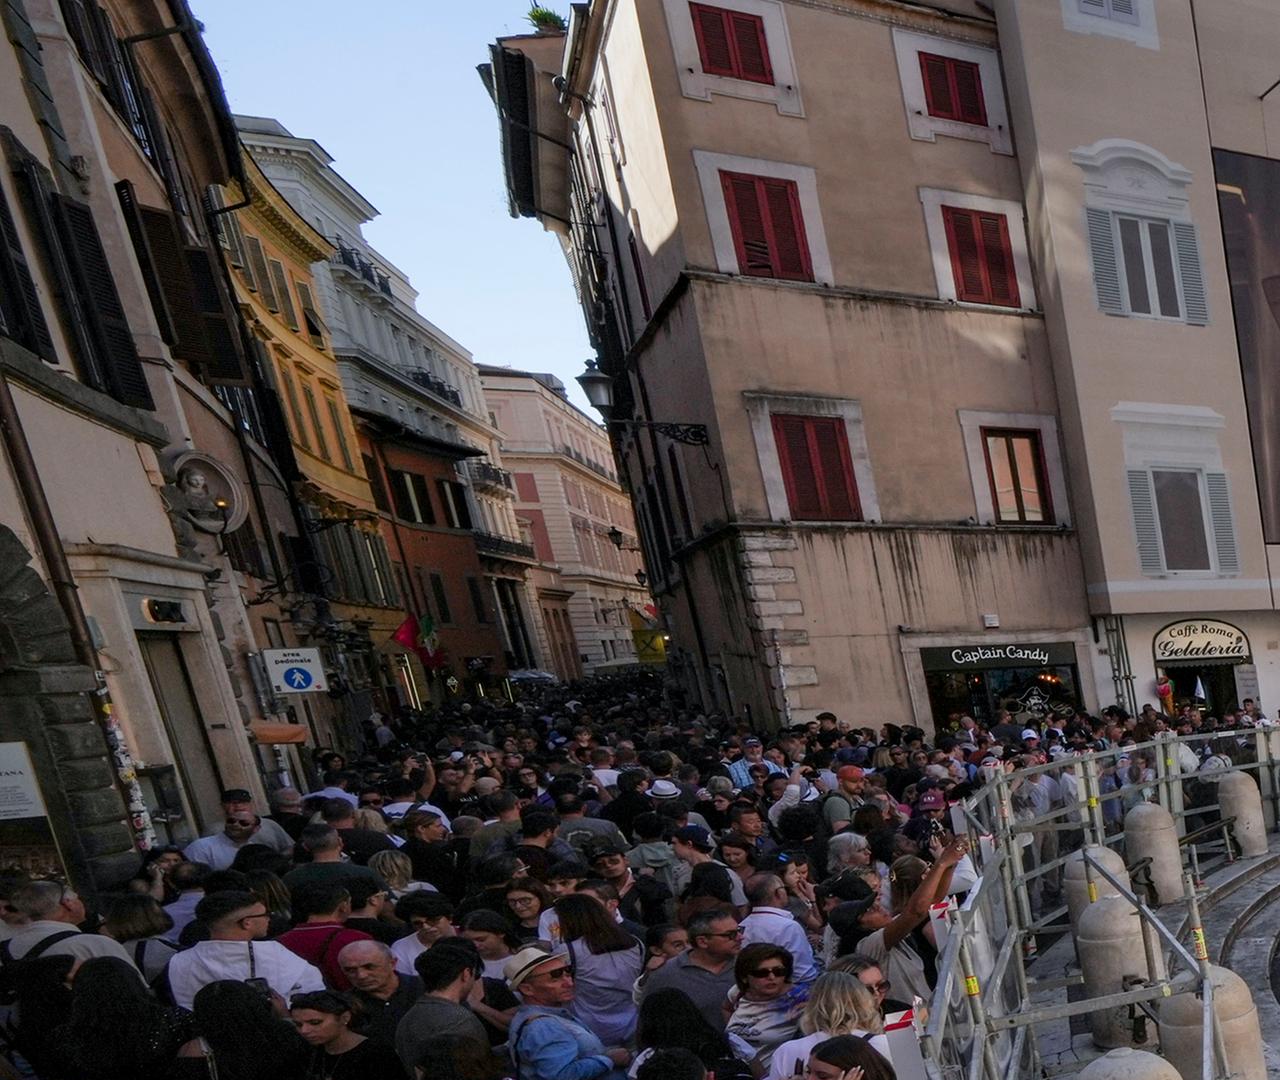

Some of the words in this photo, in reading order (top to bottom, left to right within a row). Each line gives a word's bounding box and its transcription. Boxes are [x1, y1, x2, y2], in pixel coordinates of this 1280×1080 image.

[1201, 624, 1234, 638] Roma
[952, 647, 1006, 664] Captain
[1006, 645, 1049, 665] Candy
[1158, 640, 1244, 657] Gelateria
